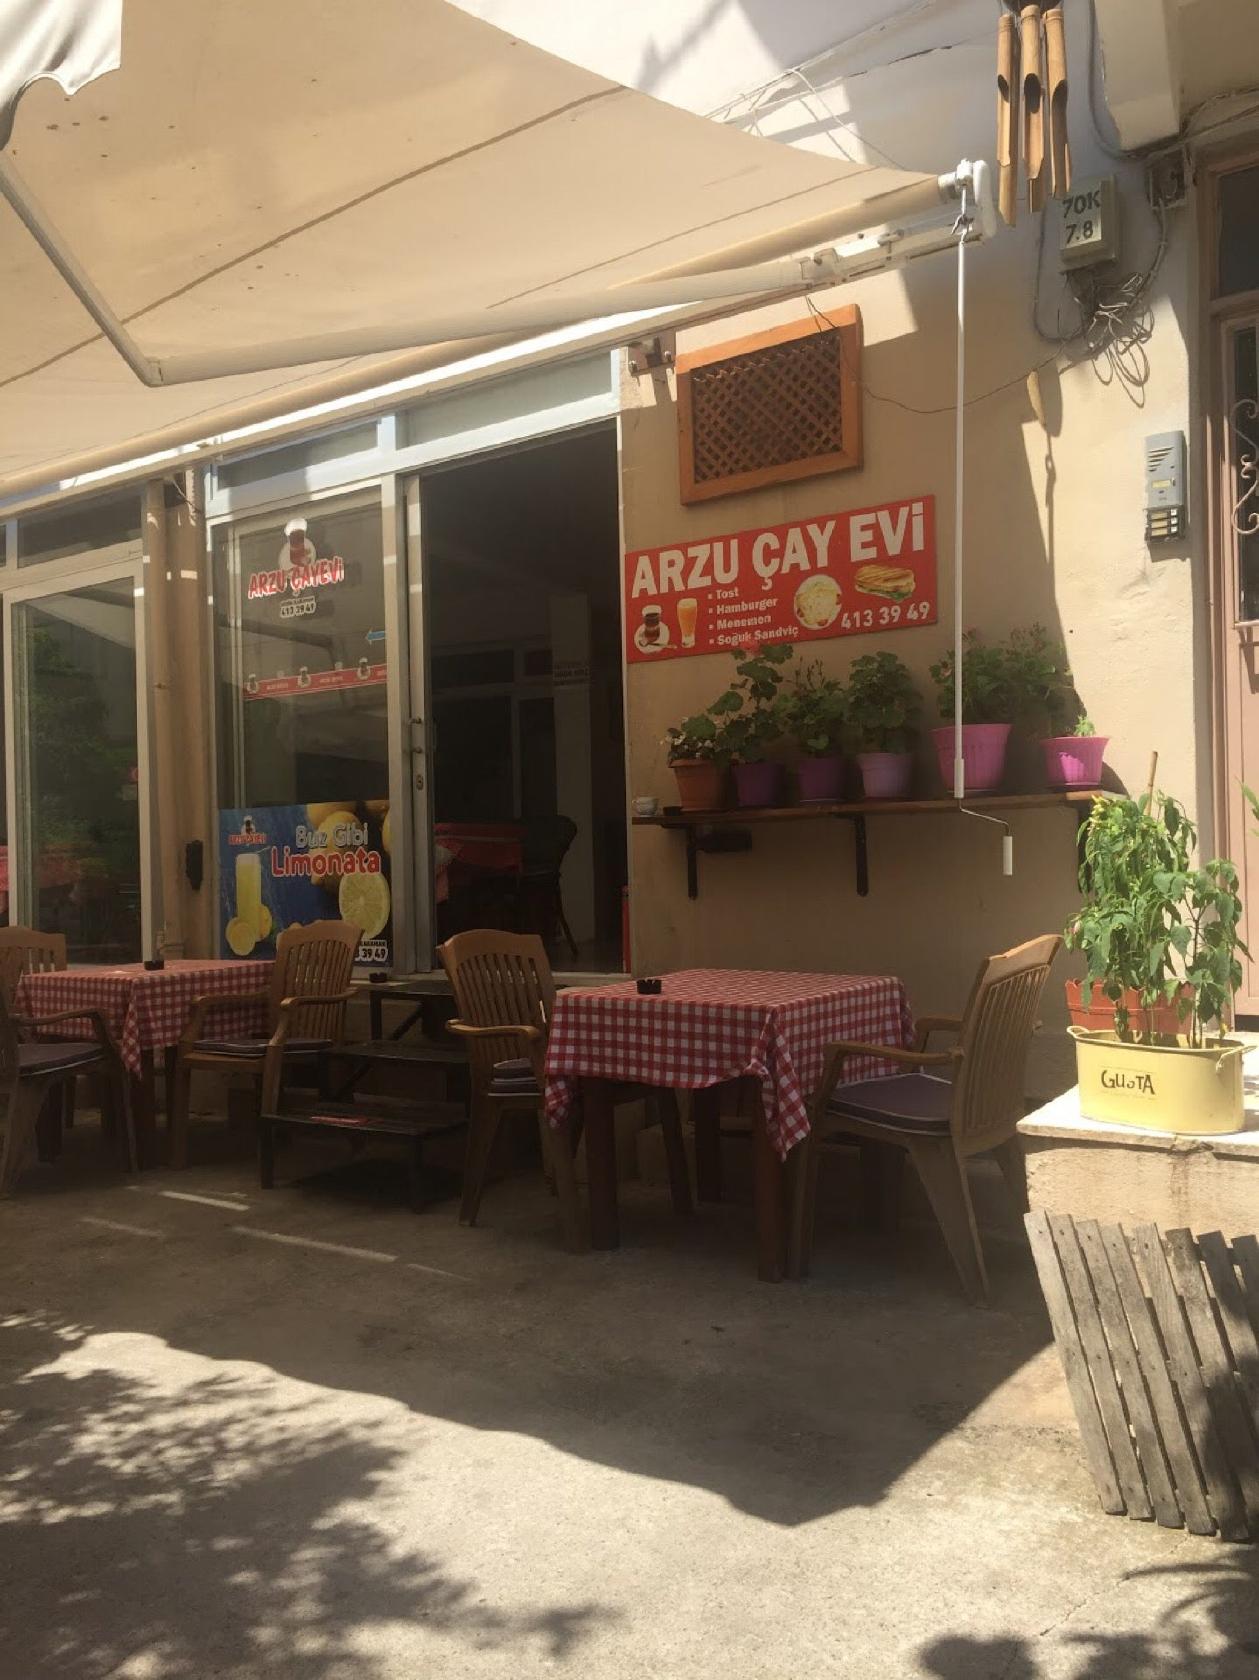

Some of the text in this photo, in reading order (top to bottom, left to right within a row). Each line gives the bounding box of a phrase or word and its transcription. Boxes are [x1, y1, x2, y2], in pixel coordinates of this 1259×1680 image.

[631, 538, 739, 598] ARZU
[752, 520, 836, 591] ÇAY
[248, 569, 287, 600] ARZU
[716, 586, 739, 600] Tost
[716, 597, 779, 615] Hamburger
[840, 601, 930, 629] 413 39 49
[716, 614, 772, 630] Menemen
[754, 626, 799, 641] Sandviç
[295, 825, 328, 849] Buz
[334, 822, 369, 848] Gibi
[270, 846, 381, 877] Limonata
[361, 947, 386, 959] 39 49
